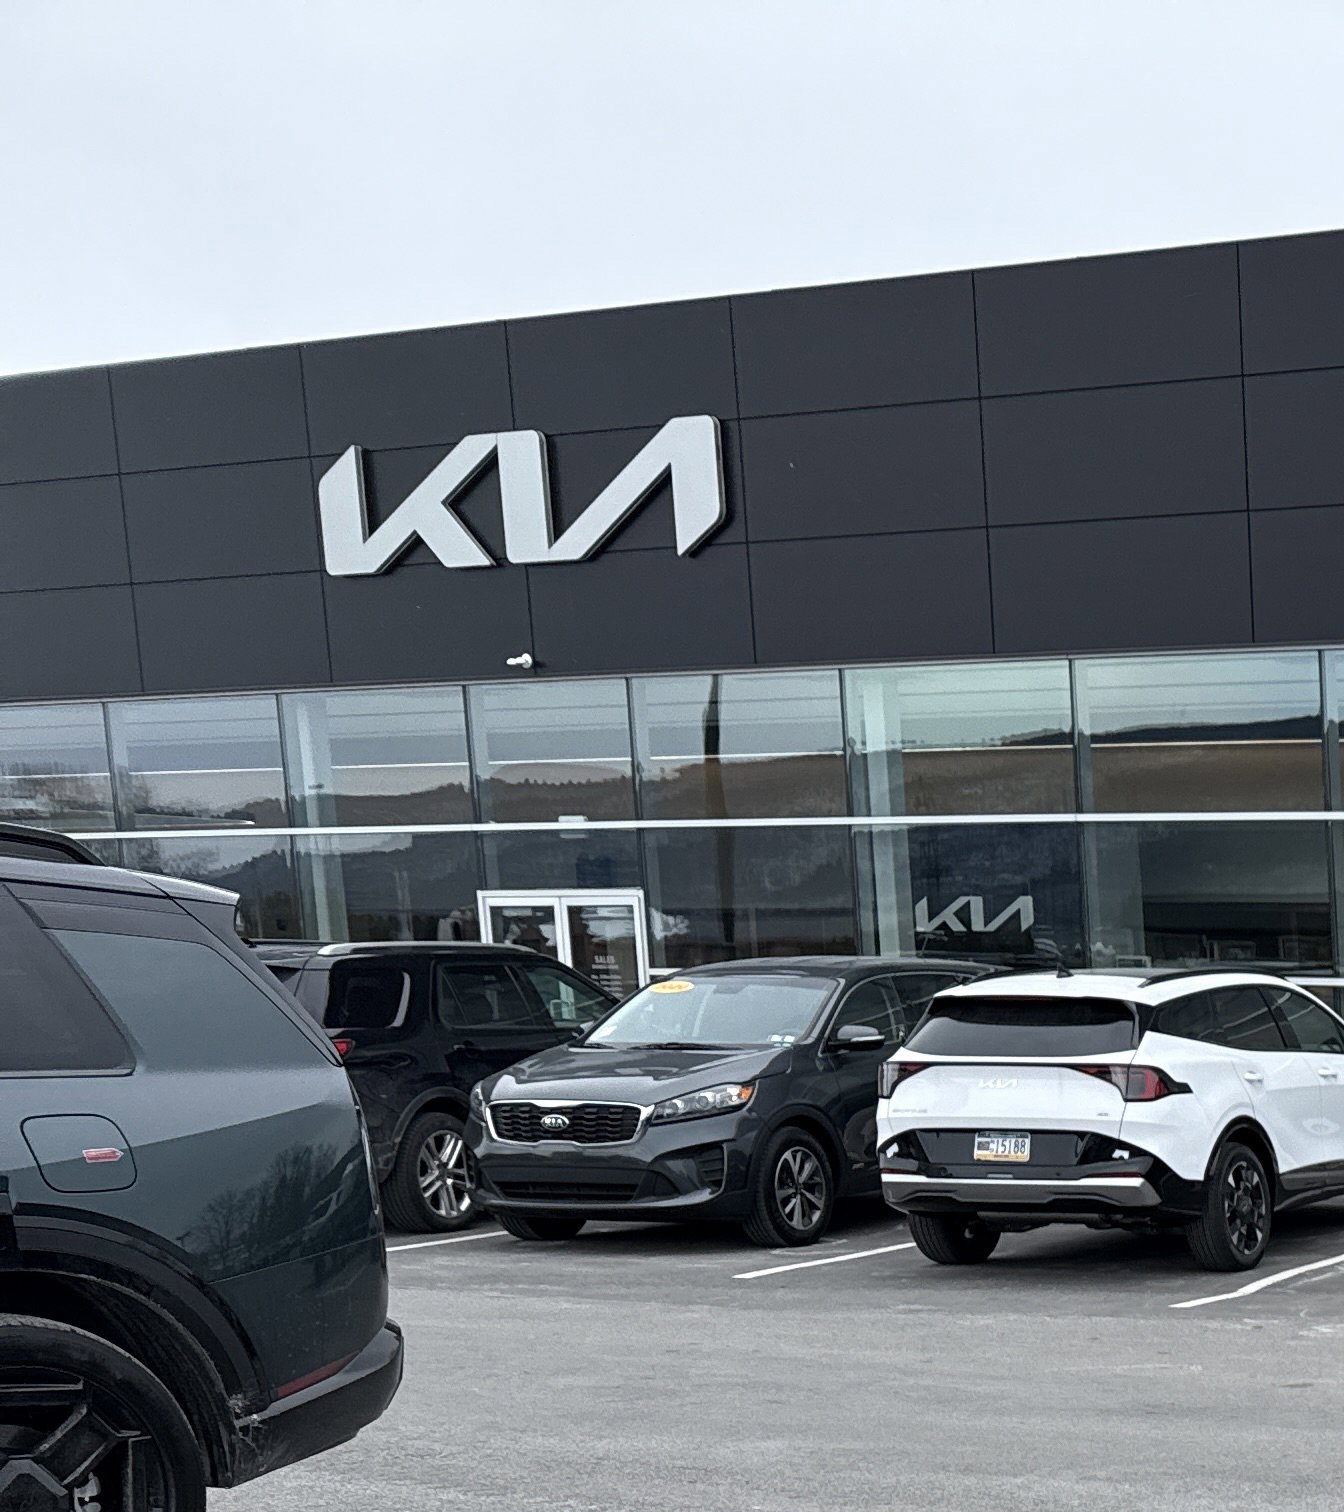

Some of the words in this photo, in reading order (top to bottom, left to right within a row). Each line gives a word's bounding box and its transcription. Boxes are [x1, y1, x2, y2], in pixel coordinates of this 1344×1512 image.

[318, 414, 726, 577] KIA
[915, 895, 1035, 932] KIA
[978, 1078, 1018, 1089] KIA
[543, 1116, 566, 1129] KIA
